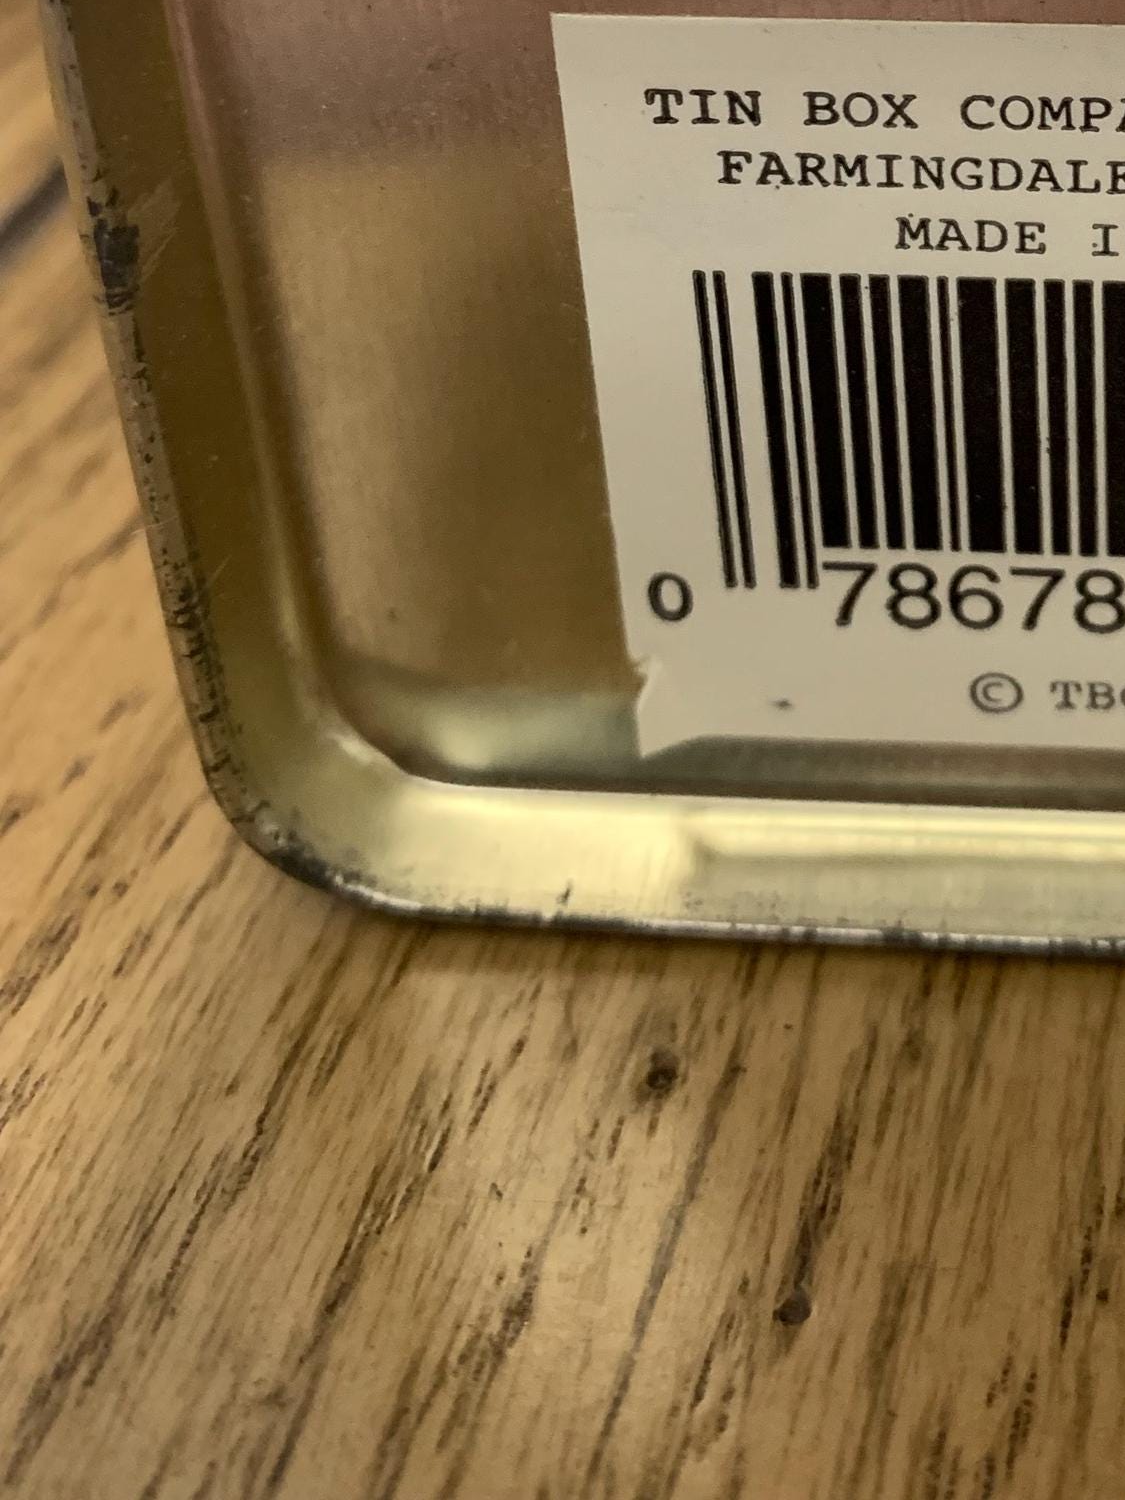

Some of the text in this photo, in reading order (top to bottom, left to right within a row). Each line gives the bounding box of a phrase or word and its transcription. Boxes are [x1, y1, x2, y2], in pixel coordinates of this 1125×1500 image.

[644, 88, 761, 126] TIN
[803, 91, 918, 129] BOX
[895, 217, 1046, 254] MADE
[647, 572, 693, 622] 0
